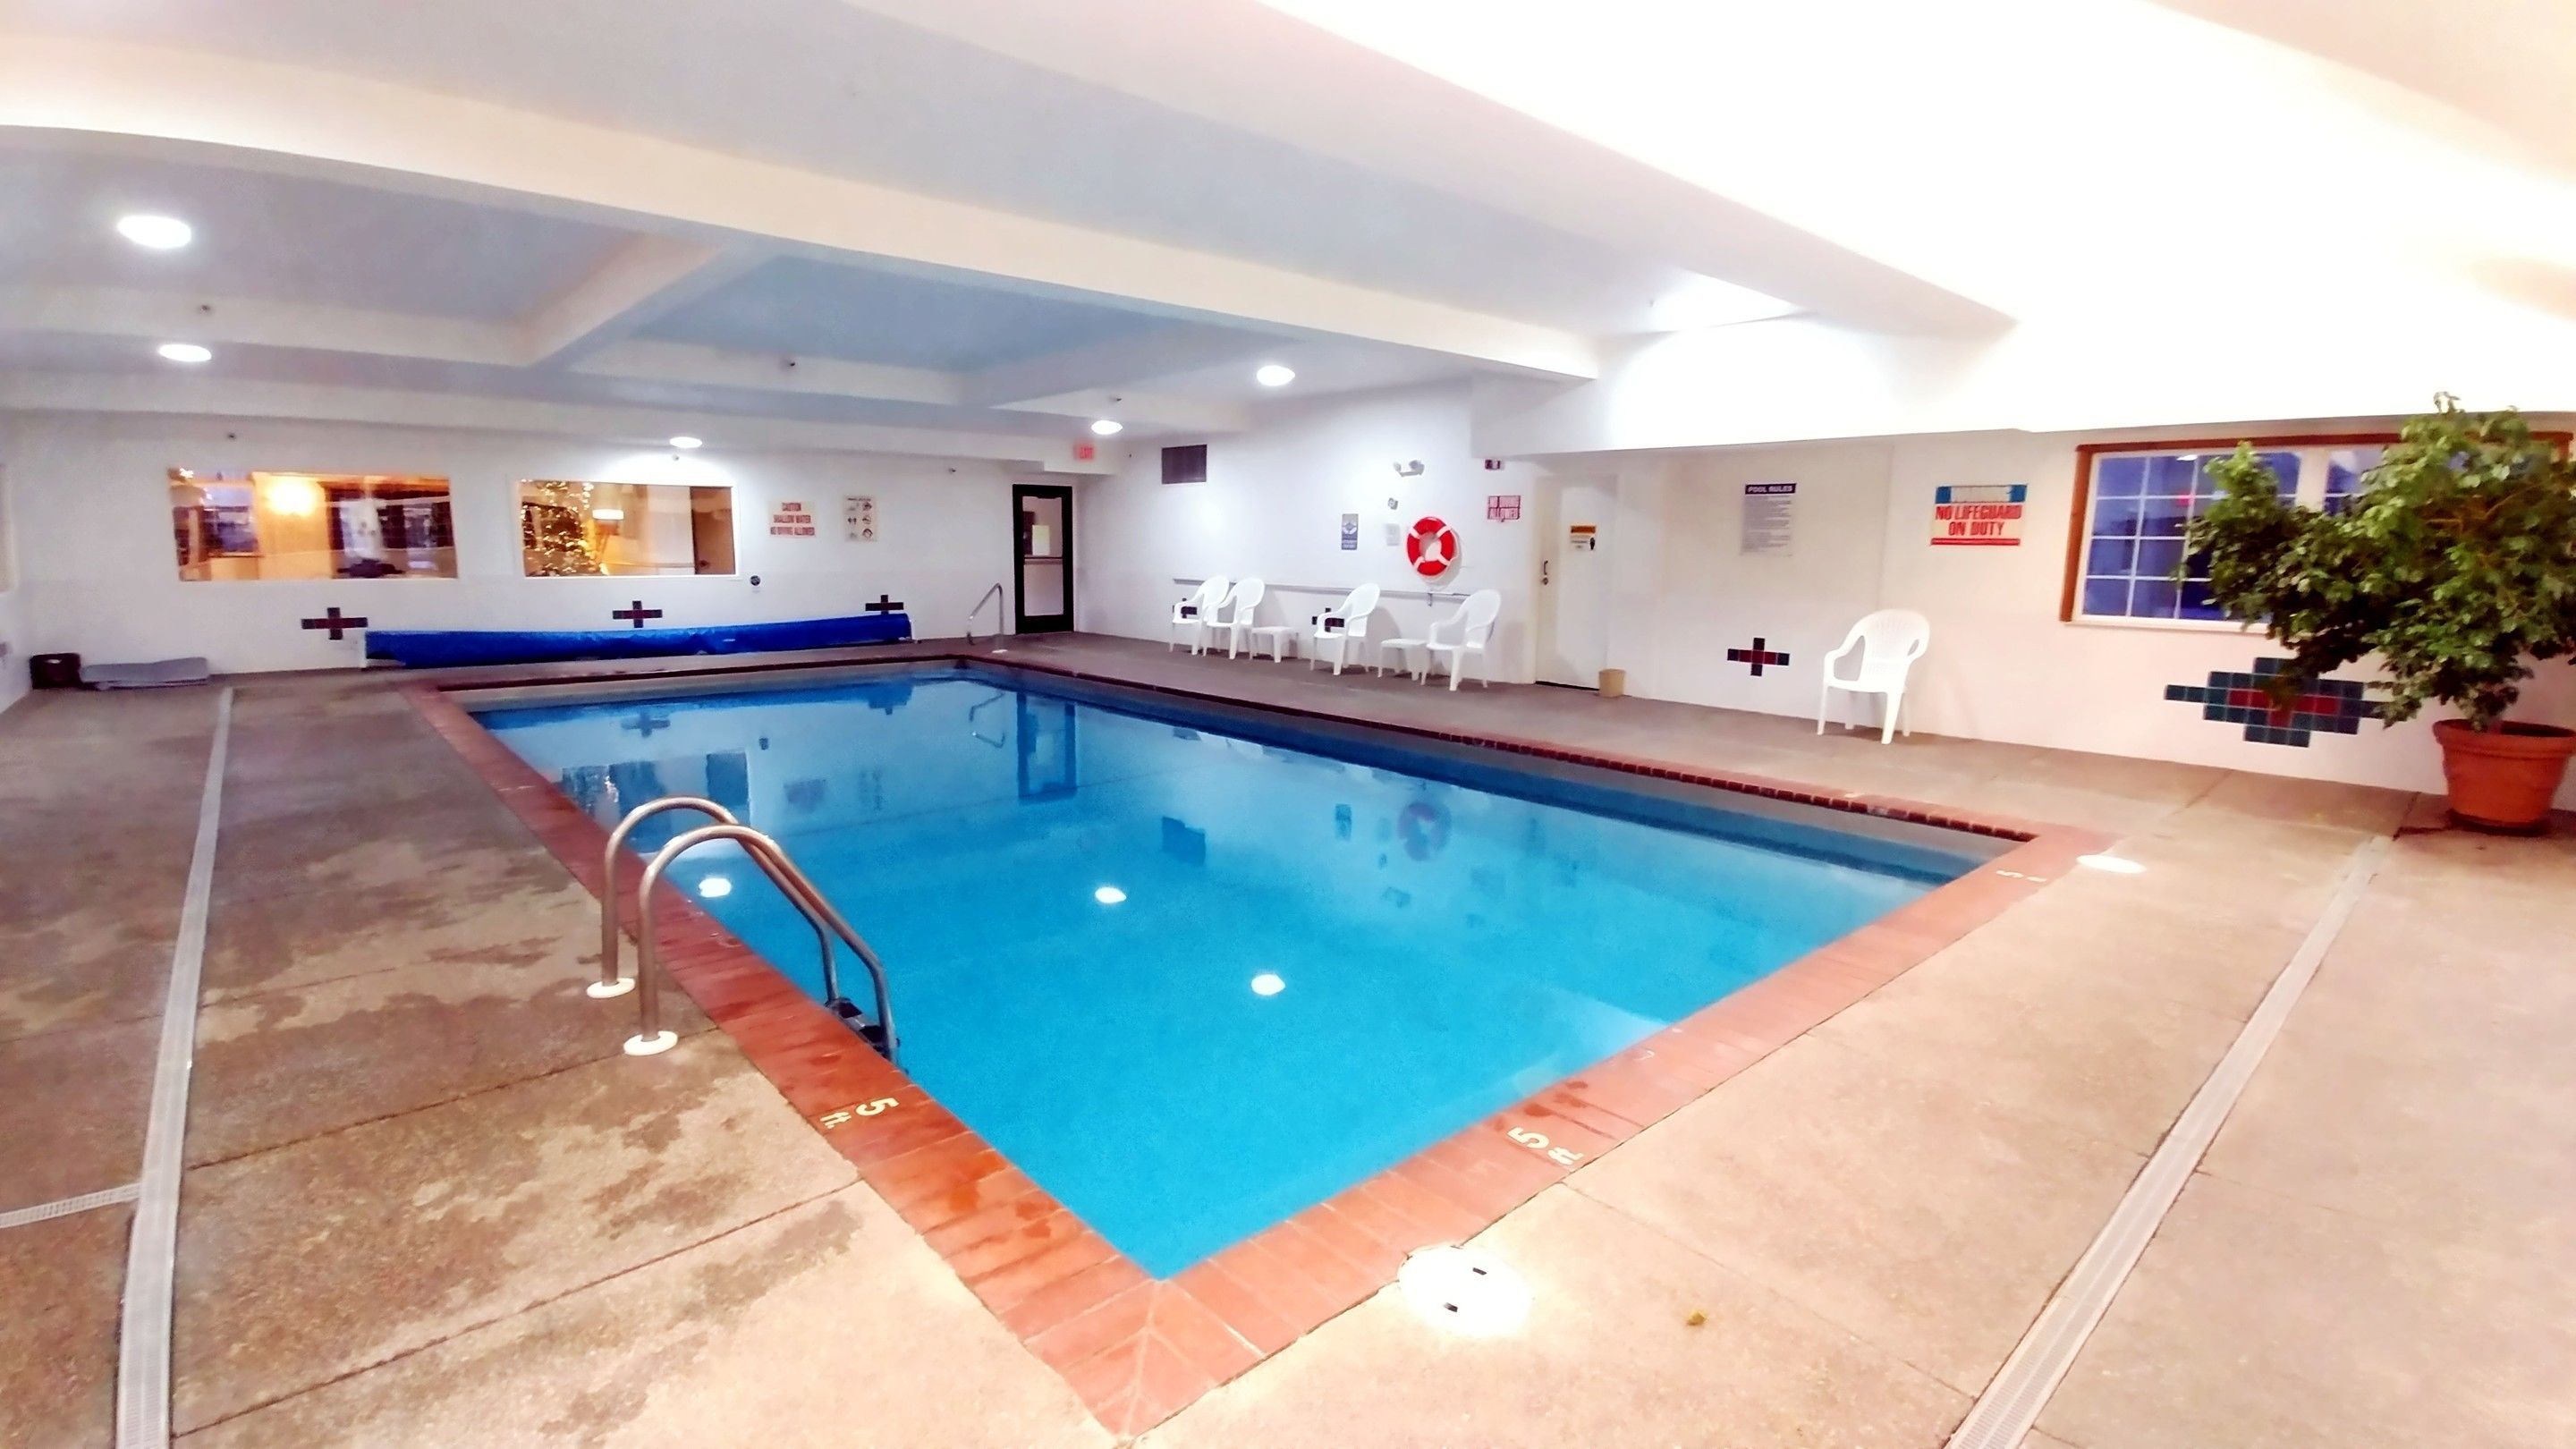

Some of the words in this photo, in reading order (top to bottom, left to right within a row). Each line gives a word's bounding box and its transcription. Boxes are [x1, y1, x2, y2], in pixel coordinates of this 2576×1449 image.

[1936, 505, 1952, 520] NO
[1954, 504, 2022, 520] LIFEGUARD
[1948, 521, 1966, 536] ON
[1970, 521, 2004, 536] DUTY
[855, 1097, 900, 1116] 5
[1506, 1126, 1550, 1149] 5
